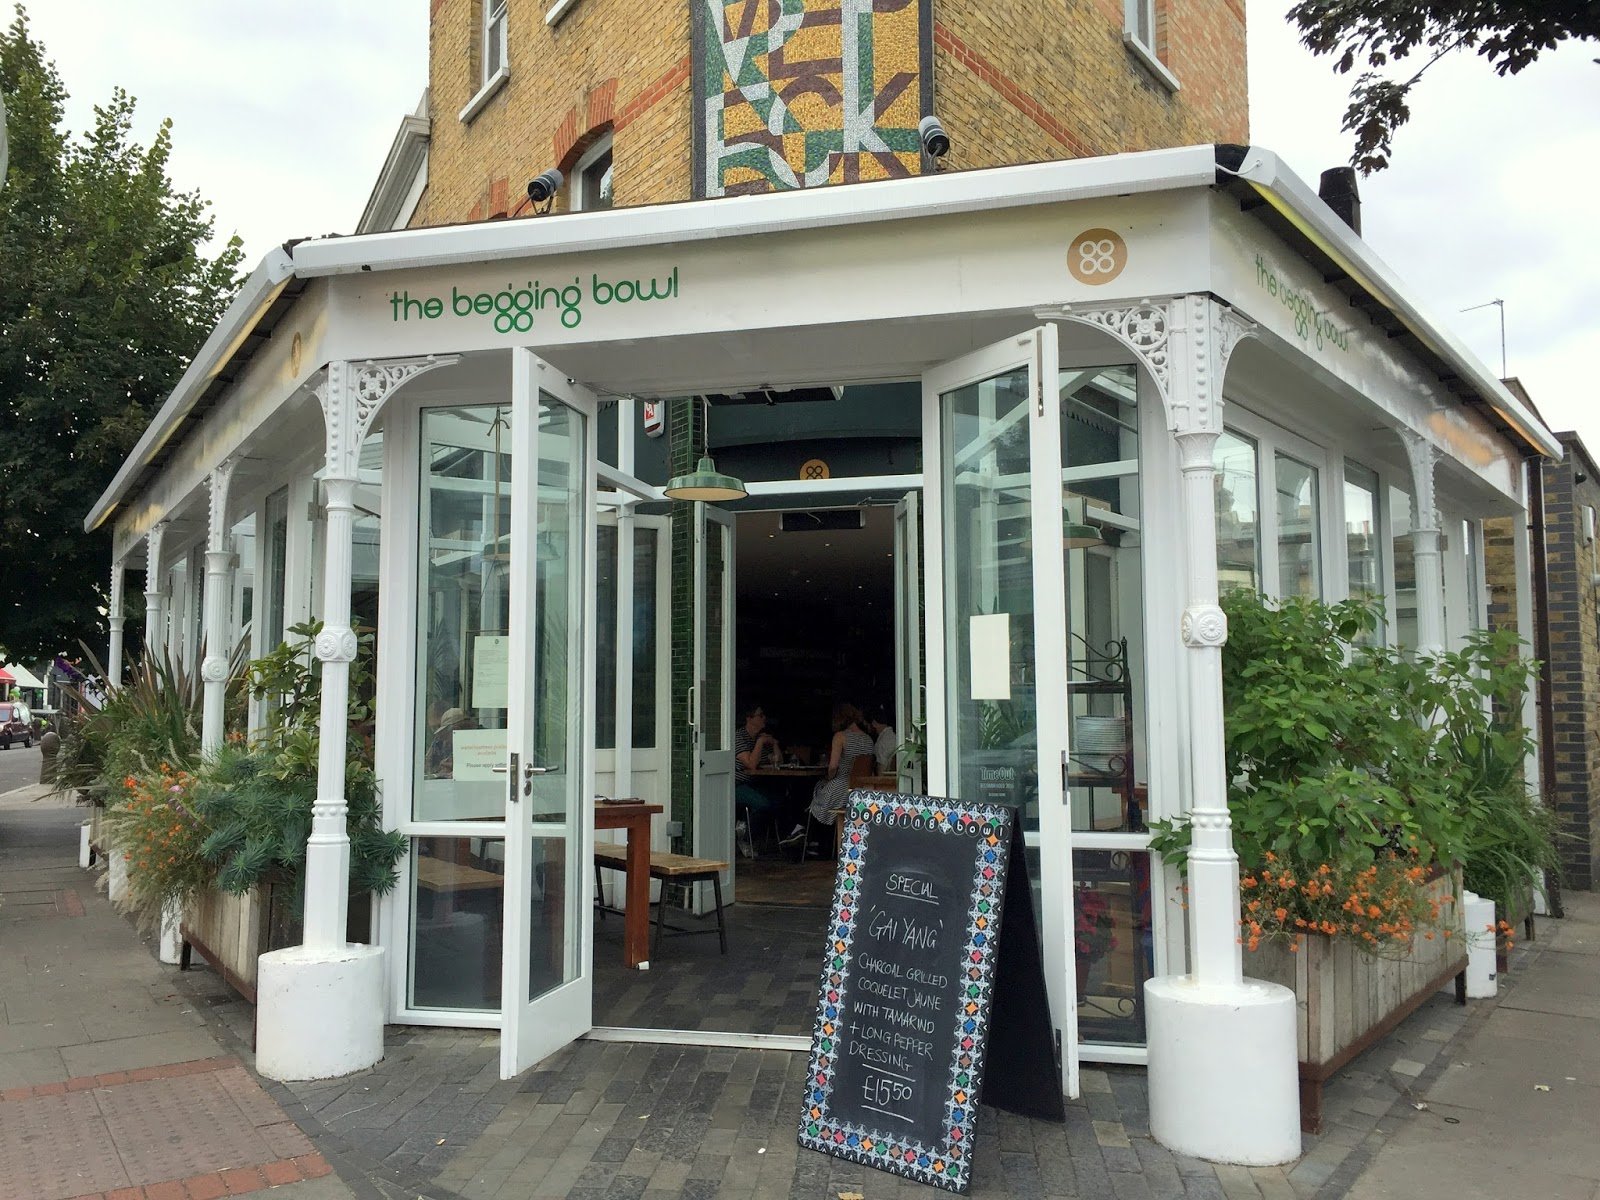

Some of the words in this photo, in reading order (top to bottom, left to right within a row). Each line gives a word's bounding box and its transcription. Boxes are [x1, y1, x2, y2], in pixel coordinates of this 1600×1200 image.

[1256, 253, 1277, 297] the
[389, 290, 444, 322] the
[452, 276, 582, 334] begging
[592, 266, 679, 305] bowl
[850, 807, 936, 831] begging
[955, 820, 1005, 838] bowl
[885, 873, 939, 899] SPECIAL
[858, 952, 904, 978] CHARCOAL
[906, 967, 948, 988] GRILLED
[857, 976, 909, 1000] COQUELET
[907, 987, 942, 1011] JAUNE
[853, 1001, 880, 1018] WITH
[881, 1006, 935, 1034] TAMARIND
[849, 1040, 913, 1072] DRESSING
[850, 1021, 860, 1035] +
[861, 1026, 891, 1046] LONG
[893, 1032, 934, 1061] PEPPER
